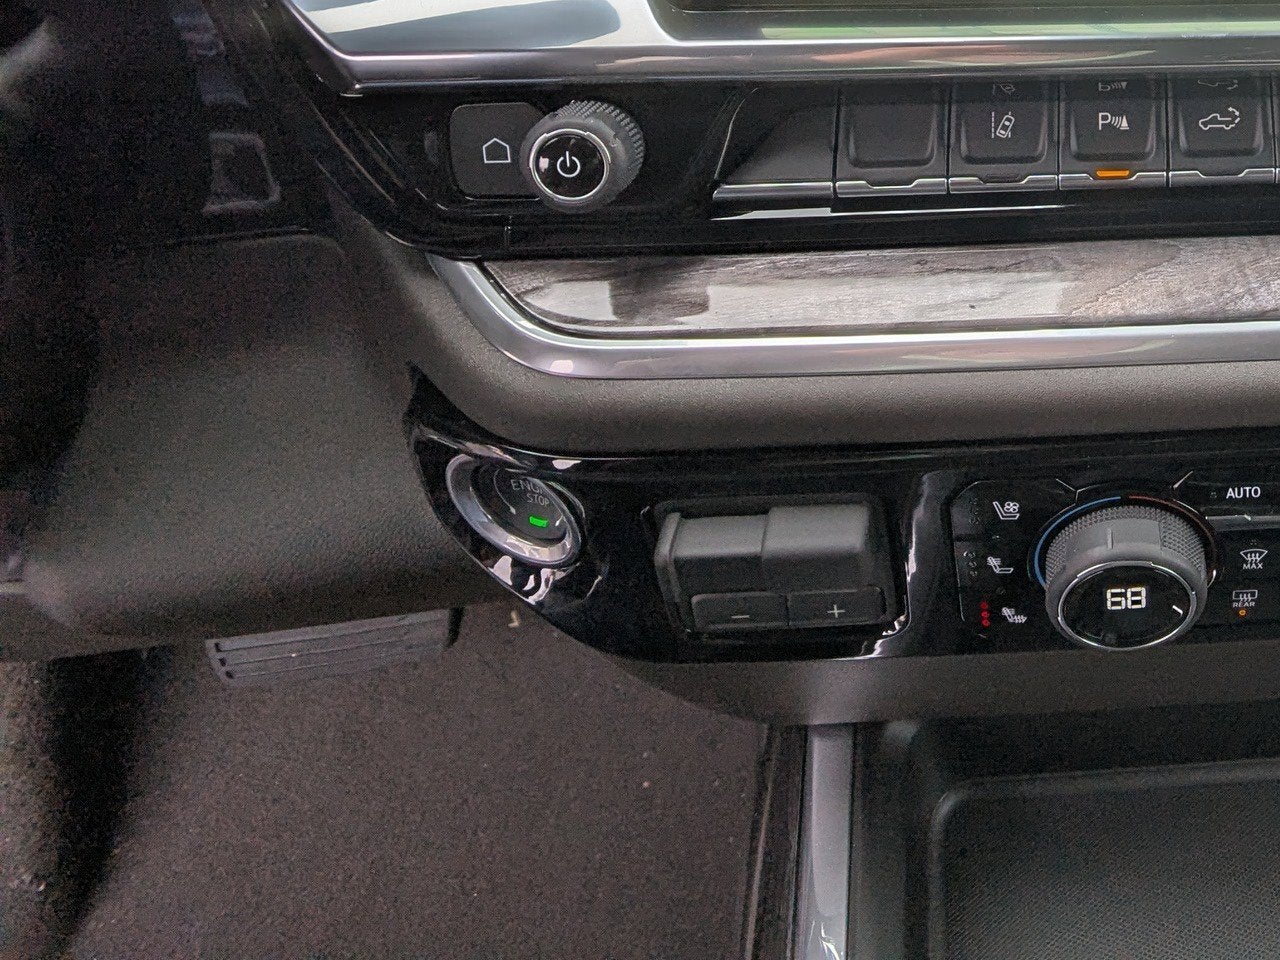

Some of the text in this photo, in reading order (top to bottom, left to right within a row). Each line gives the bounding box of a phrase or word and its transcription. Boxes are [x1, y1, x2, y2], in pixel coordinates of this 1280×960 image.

[1226, 486, 1261, 499] AUTO
[1242, 561, 1264, 570] MAX
[1106, 586, 1147, 611] 68
[1232, 599, 1256, 608] REAR
